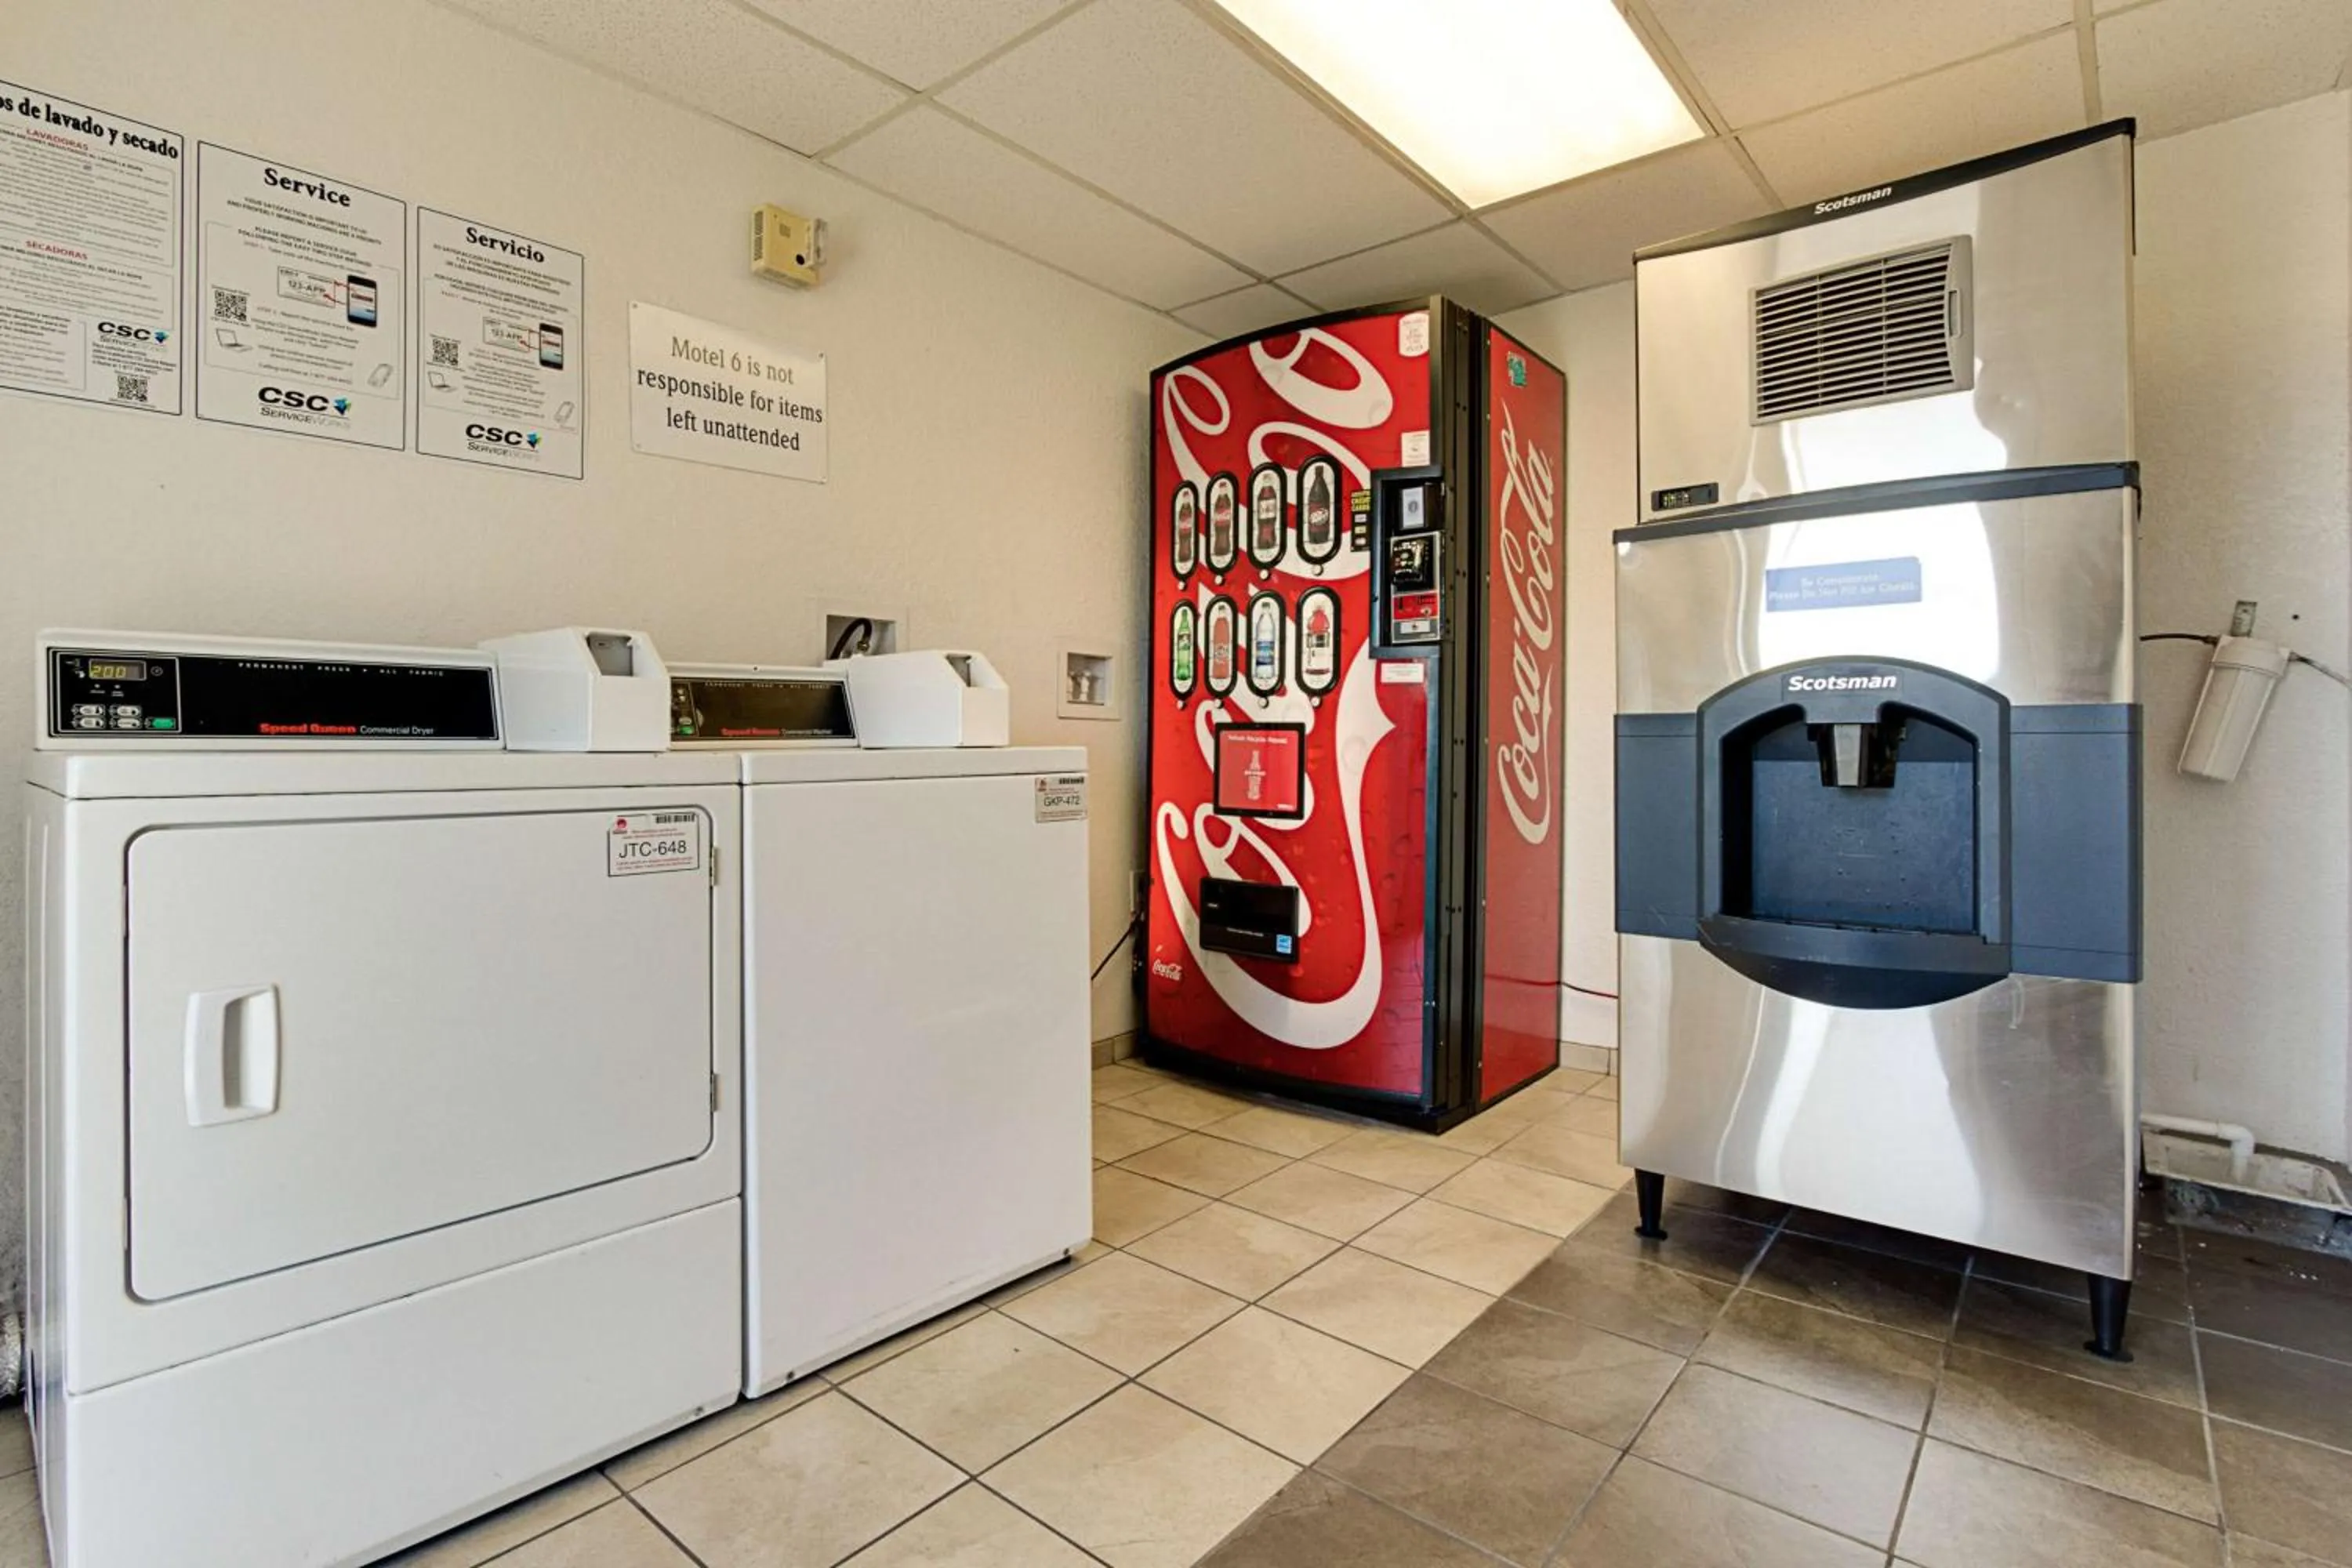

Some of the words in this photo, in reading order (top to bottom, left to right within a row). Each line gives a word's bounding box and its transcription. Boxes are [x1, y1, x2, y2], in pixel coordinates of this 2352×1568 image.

[18, 97, 41, 118] de
[45, 104, 103, 136] lavado
[108, 128, 118, 146] y
[122, 132, 178, 158] secado
[26, 129, 89, 151] LAVADORAS
[264, 167, 350, 207] Service
[1814, 187, 1892, 214] Scotsman
[25, 241, 88, 260] SECADORAS
[466, 227, 545, 263] Servicio
[98, 321, 151, 340] CSC
[671, 336, 724, 368] Motel
[731, 352, 741, 372] 6
[747, 356, 760, 377] is
[767, 365, 794, 385] not
[258, 387, 329, 412] CSC
[637, 369, 744, 406] responsible
[750, 390, 774, 413] for
[779, 397, 822, 423] items
[466, 424, 522, 445] CSC
[666, 408, 697, 432] left
[703, 419, 800, 452] unattended
[1497, 397, 1554, 844] Coca-Cola
[1788, 675, 1897, 691] Scotsman
[259, 723, 307, 735] Speed
[310, 724, 356, 734] Queen
[360, 725, 410, 735] Commercial
[412, 726, 434, 736] Dryer
[619, 840, 687, 858] JTC-648
